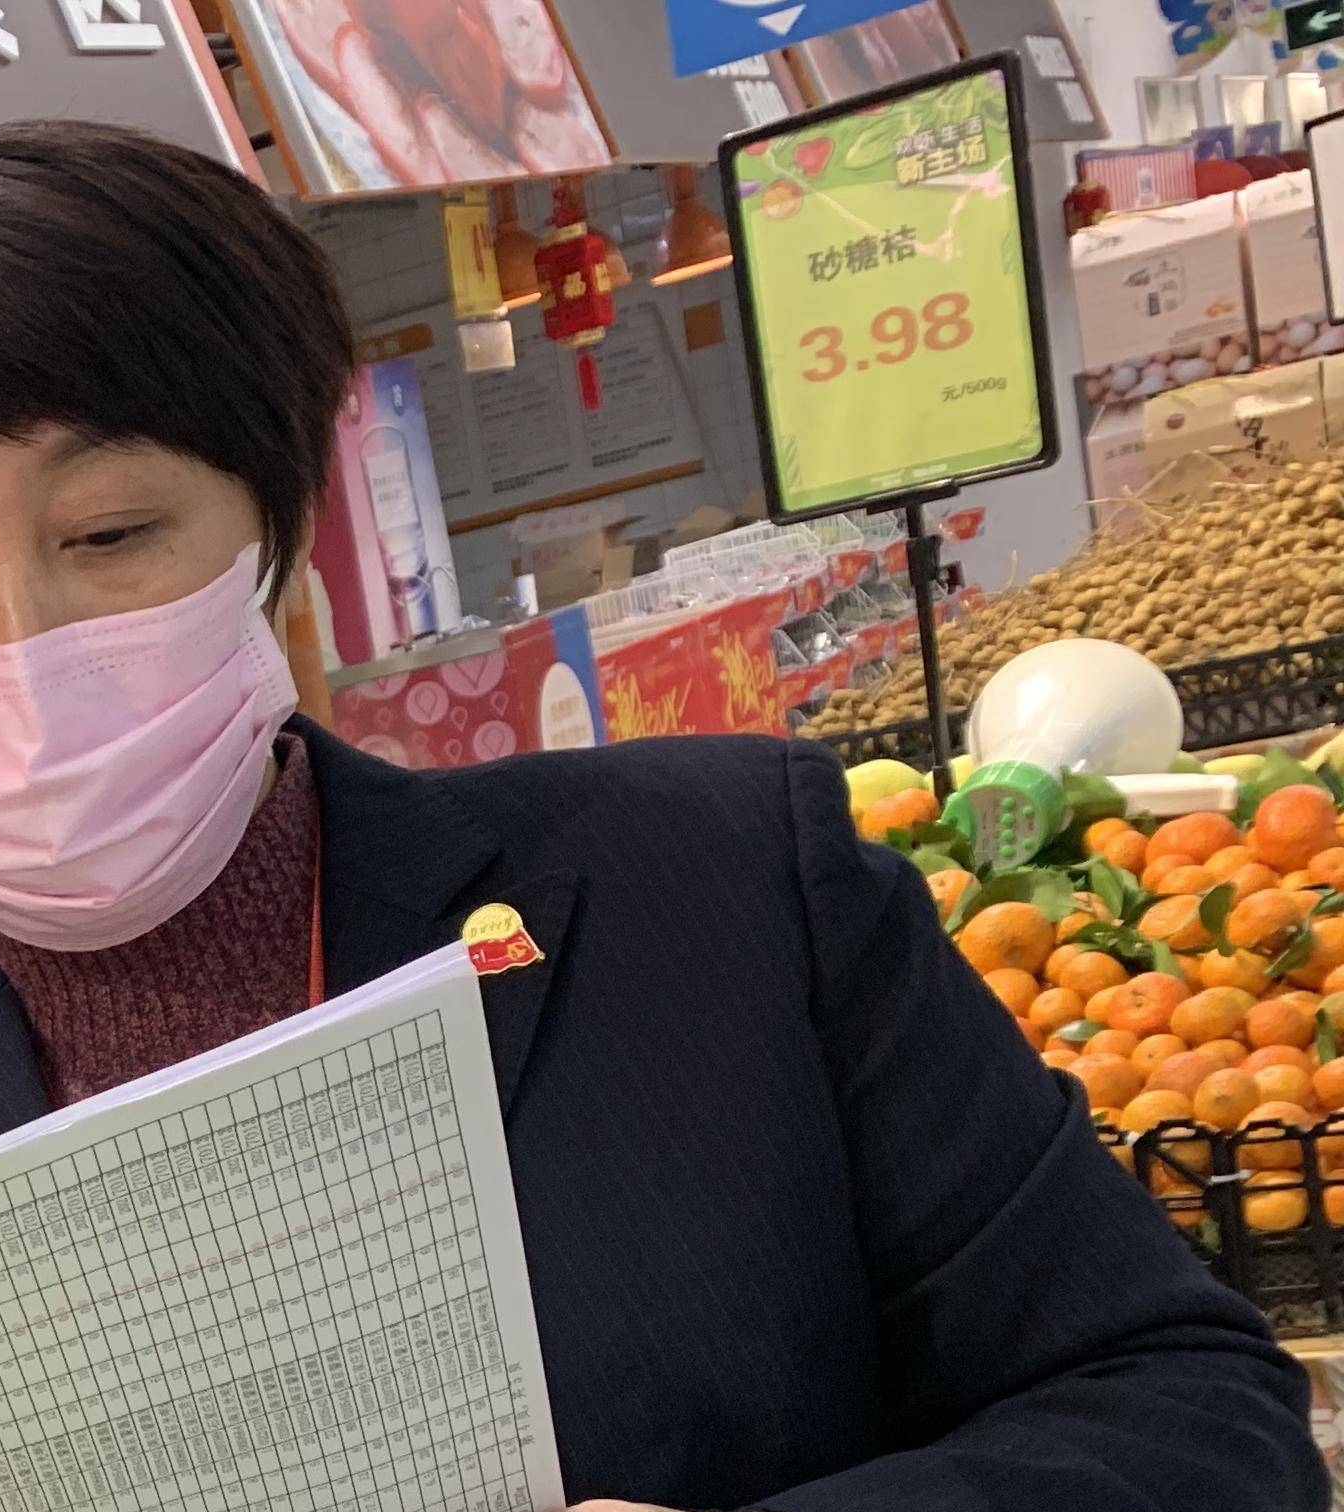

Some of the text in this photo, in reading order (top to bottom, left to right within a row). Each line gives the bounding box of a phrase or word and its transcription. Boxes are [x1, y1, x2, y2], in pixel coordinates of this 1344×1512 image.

[808, 224, 918, 282] 砂糖桔
[799, 292, 975, 383] 3.98
